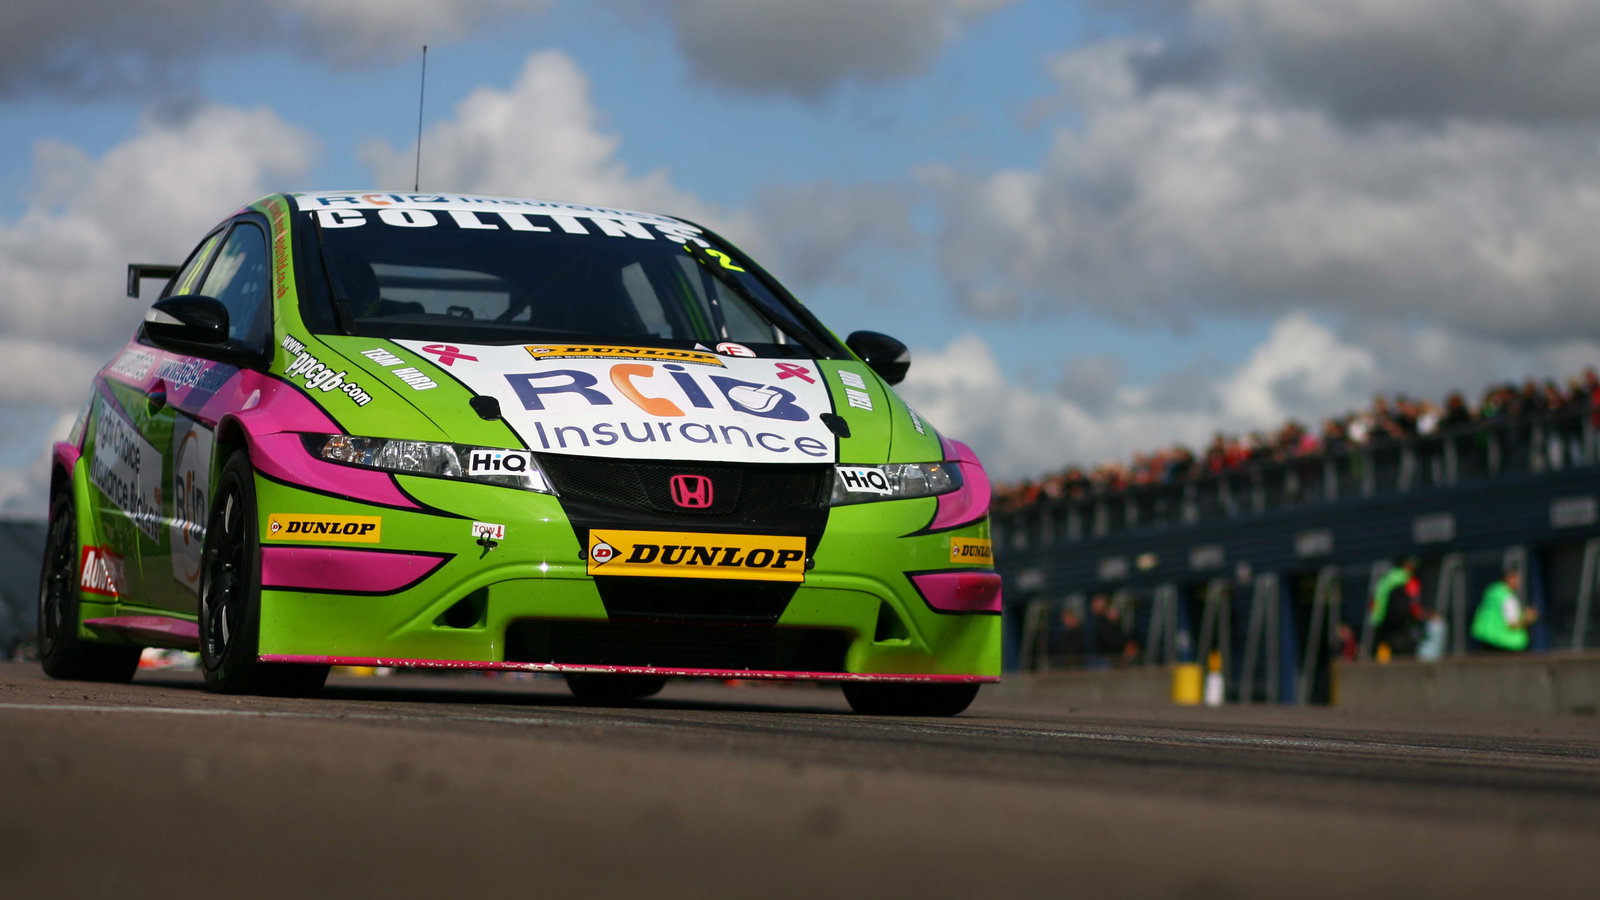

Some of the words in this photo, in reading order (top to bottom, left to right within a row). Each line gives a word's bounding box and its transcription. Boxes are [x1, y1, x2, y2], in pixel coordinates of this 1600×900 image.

[309, 209, 711, 248] COLLINS
[564, 347, 716, 360] DUNLOP
[360, 348, 406, 367] TEAM
[391, 367, 438, 391] HARD
[113, 415, 141, 474] Choice
[533, 420, 828, 457] Insurance
[472, 453, 527, 473] HiQ
[841, 470, 889, 491] HiQ
[285, 521, 376, 535] DUNLOP
[474, 524, 496, 535] TOW
[625, 543, 804, 569] DUNLOP
